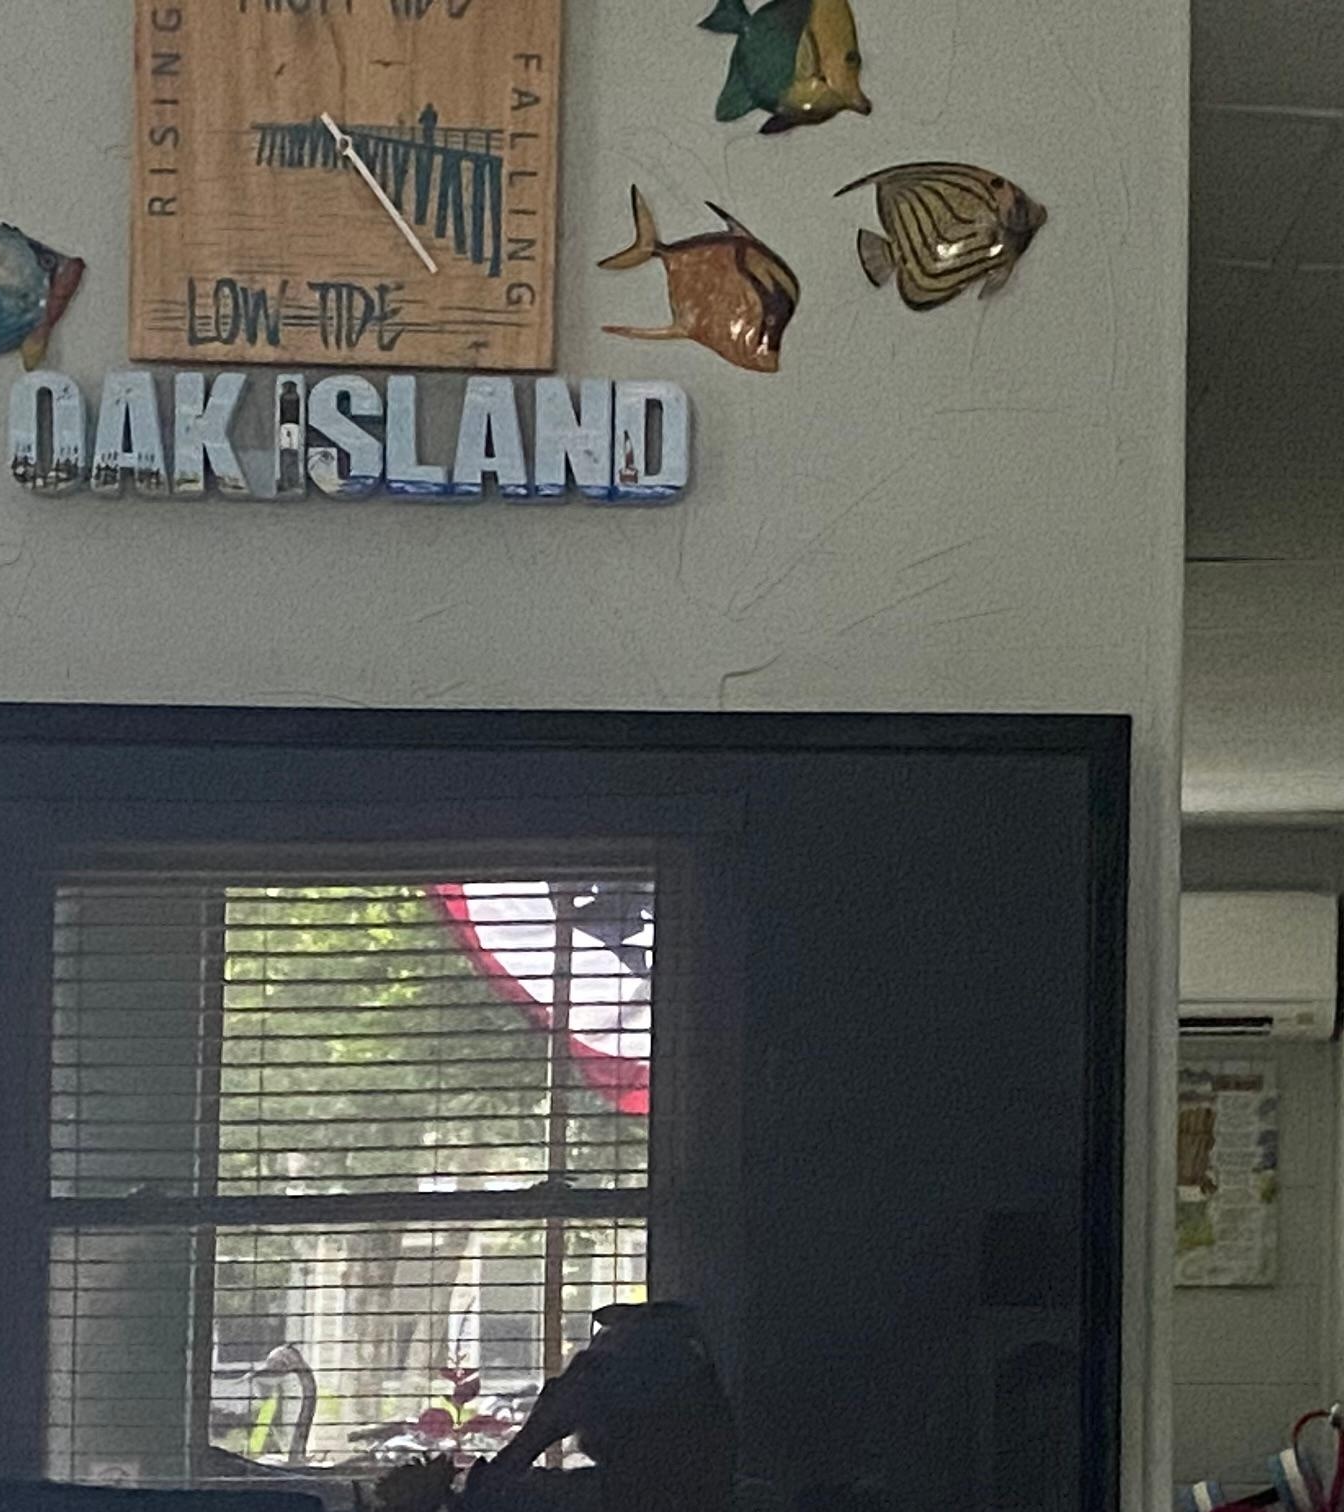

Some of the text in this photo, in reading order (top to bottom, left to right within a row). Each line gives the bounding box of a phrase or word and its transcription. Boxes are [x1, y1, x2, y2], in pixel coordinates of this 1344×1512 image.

[147, 7, 182, 217] RISING
[505, 52, 543, 308] FALLING
[187, 276, 405, 352] LOW TIDE
[8, 370, 690, 502] OAK ISLAND
